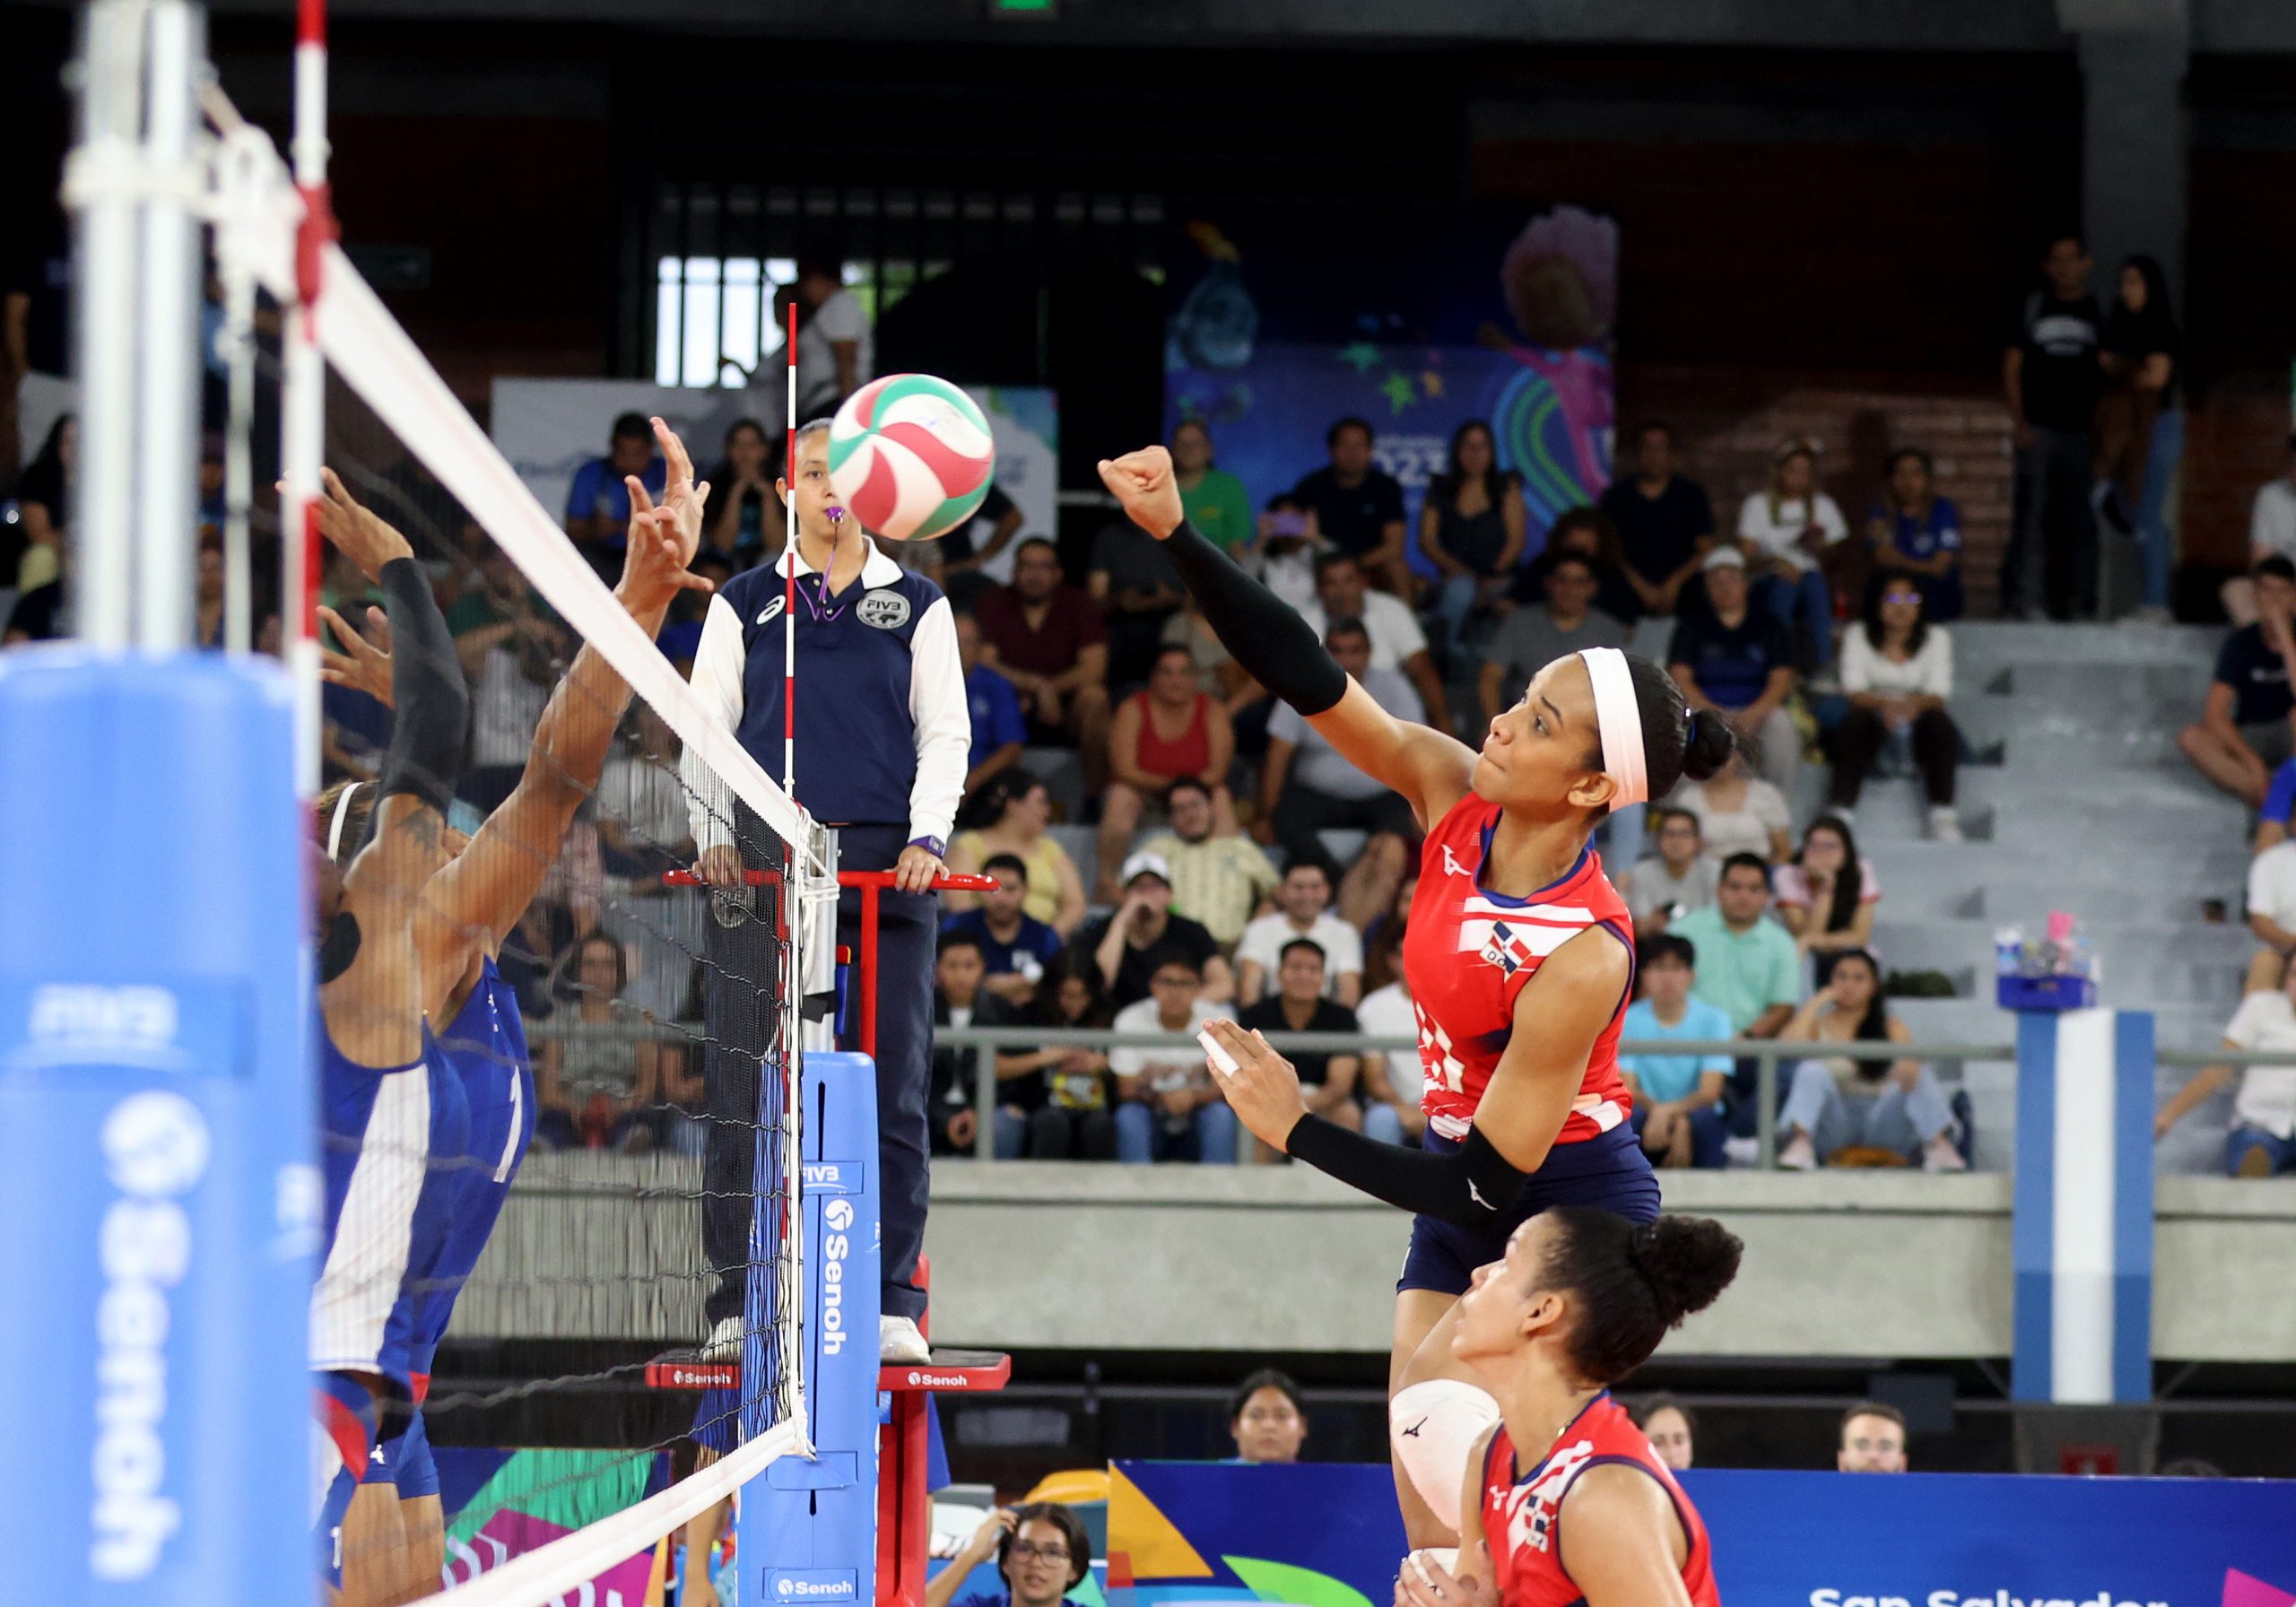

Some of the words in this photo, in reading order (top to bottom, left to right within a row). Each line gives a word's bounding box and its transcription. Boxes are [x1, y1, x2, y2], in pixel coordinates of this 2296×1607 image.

[867, 599, 901, 611] FIVB
[823, 1234, 849, 1355] Senoh
[921, 1374, 968, 1386] Senoh
[795, 1580, 853, 1595] Senoh
